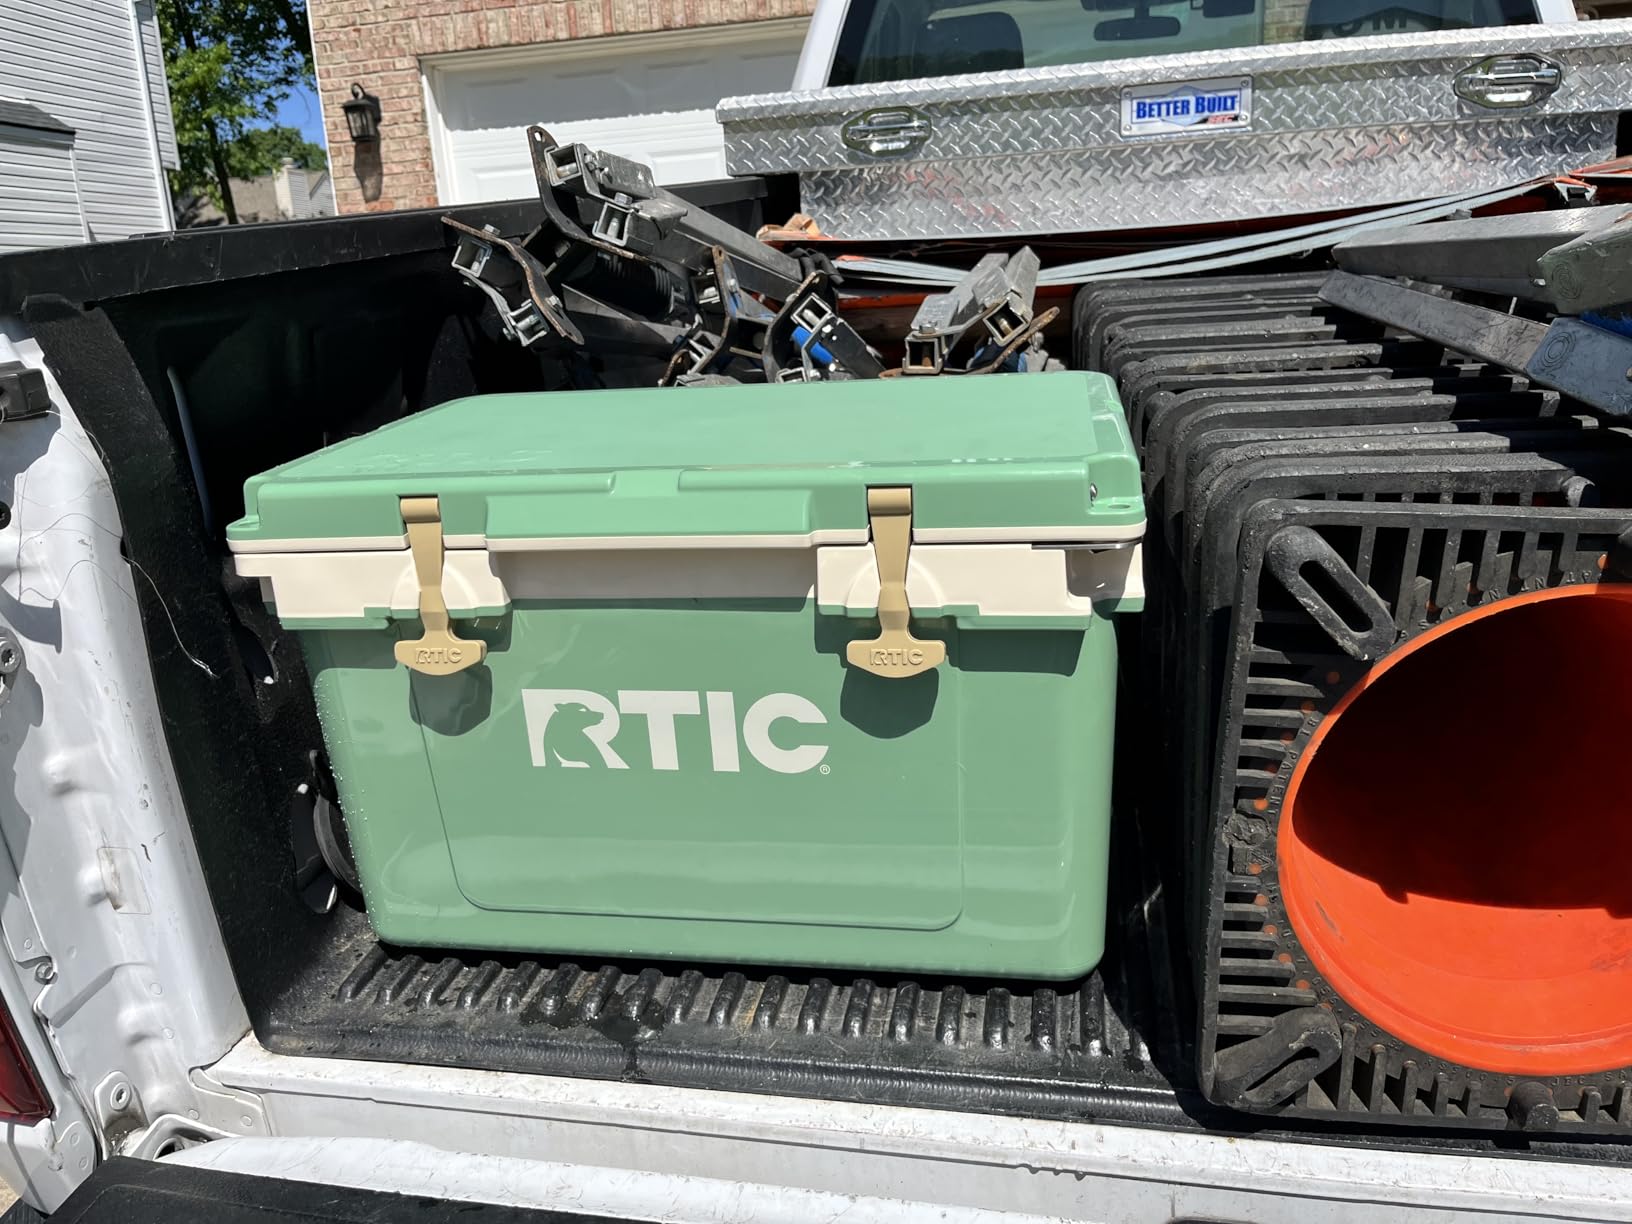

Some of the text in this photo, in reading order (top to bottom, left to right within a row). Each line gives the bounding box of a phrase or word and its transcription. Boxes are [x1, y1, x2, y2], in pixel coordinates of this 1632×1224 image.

[1136, 95, 1238, 119] BETTER BUILT
[415, 647, 463, 664] RTIC
[870, 648, 924, 666] RTIC
[521, 688, 829, 774] RTIC
